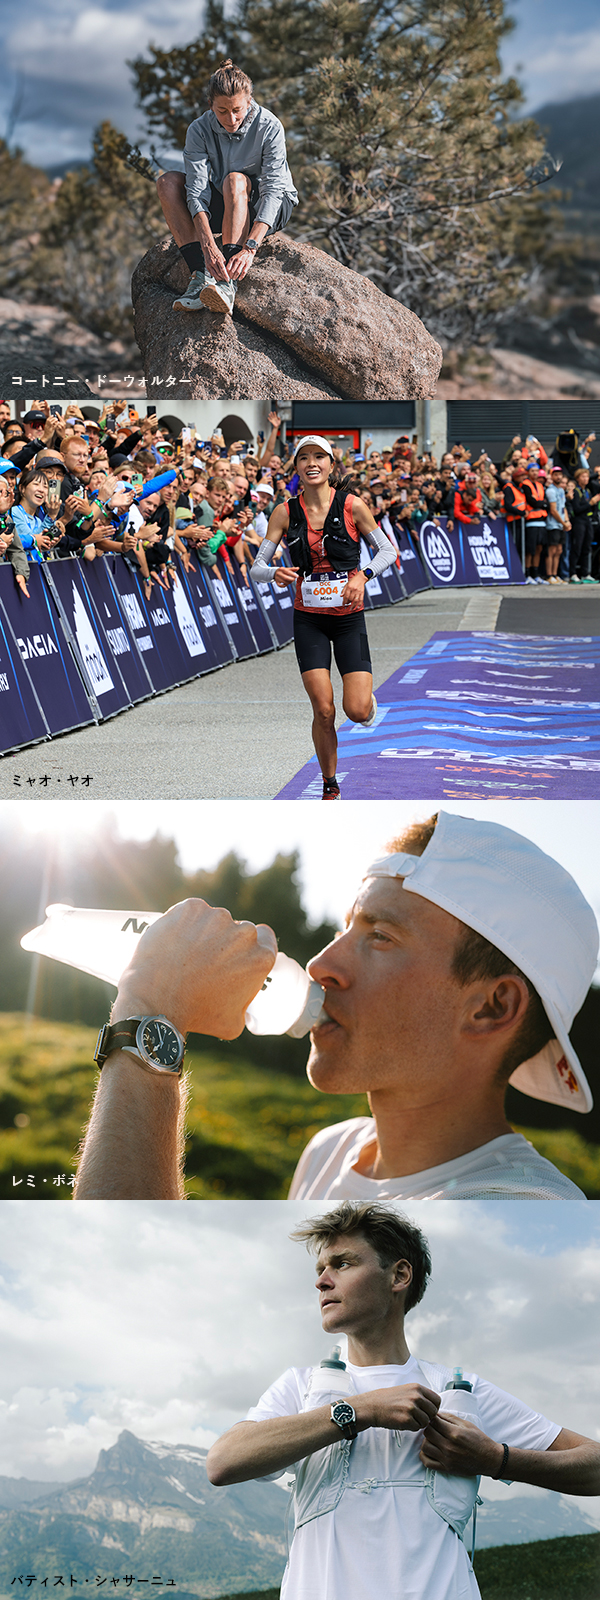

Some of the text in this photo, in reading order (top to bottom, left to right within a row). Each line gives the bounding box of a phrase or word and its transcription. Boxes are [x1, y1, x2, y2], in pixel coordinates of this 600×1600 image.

[470, 546, 505, 566] UTMB
[313, 586, 339, 596] 6004
[16, 633, 58, 660] DACIA
